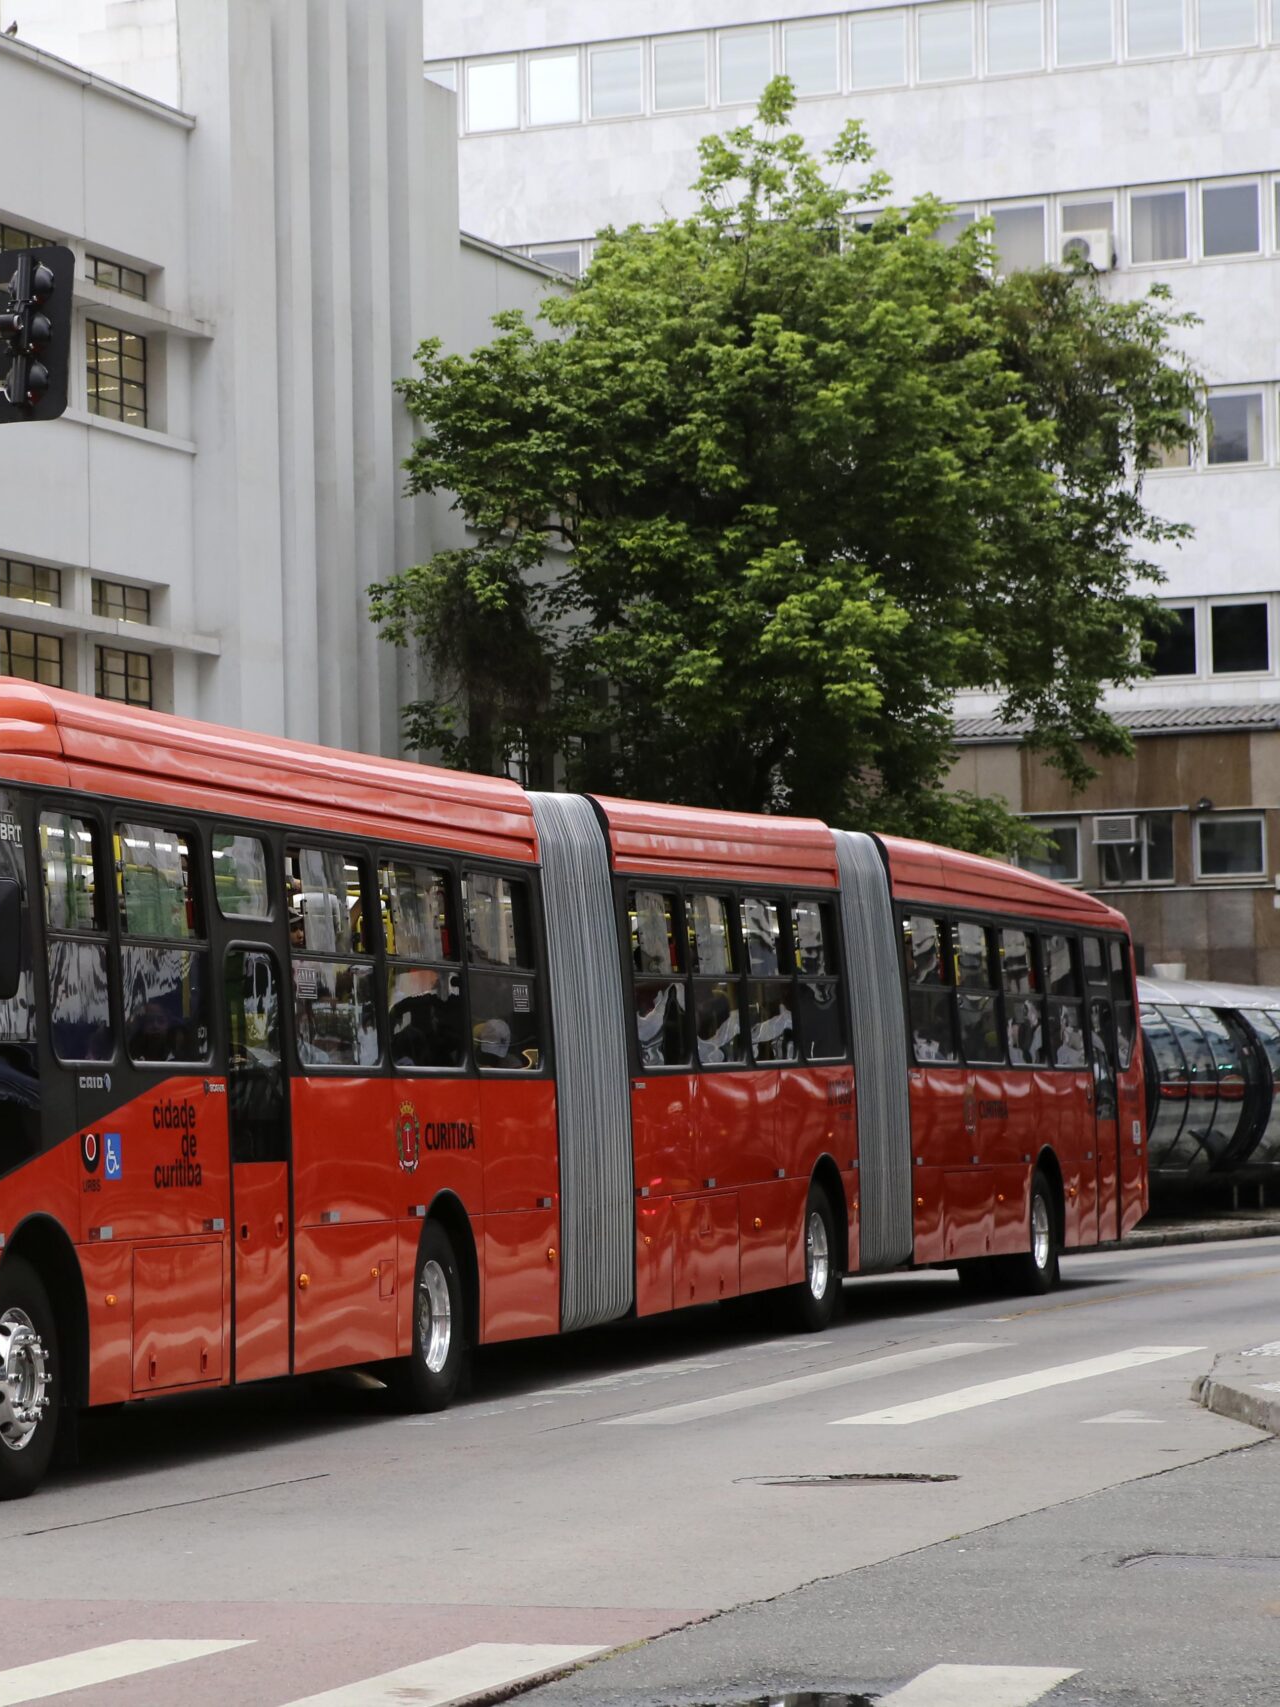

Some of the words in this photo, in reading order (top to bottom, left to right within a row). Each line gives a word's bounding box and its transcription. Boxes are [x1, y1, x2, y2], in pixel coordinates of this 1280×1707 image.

[0, 823, 22, 842] BRT
[79, 1076, 104, 1089] CAIO
[152, 1098, 196, 1130] cidade
[181, 1130, 197, 1157] de
[424, 1122, 476, 1150] CURITIBA
[154, 1157, 202, 1189] curitiba
